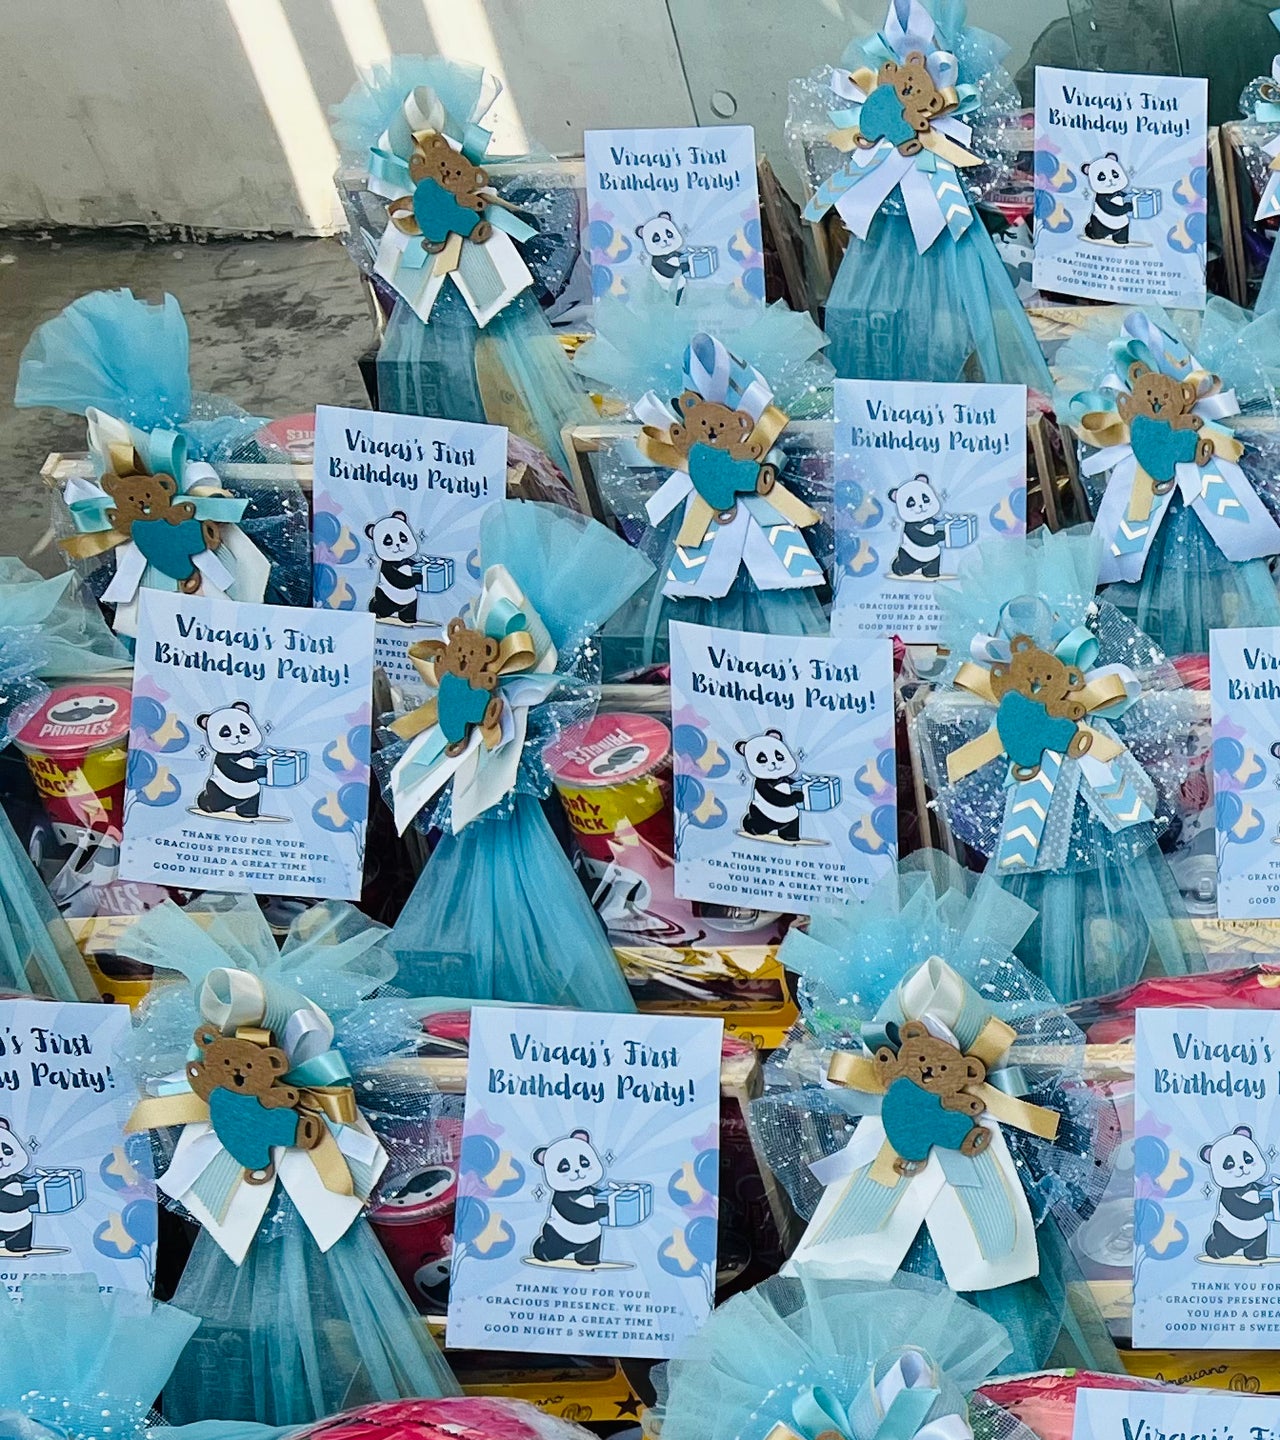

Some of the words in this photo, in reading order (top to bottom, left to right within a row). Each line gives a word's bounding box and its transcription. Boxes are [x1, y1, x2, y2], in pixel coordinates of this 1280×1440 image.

[176, 615, 275, 649] Viraaj's
[284, 628, 337, 656] First
[157, 644, 264, 680] Birthday
[276, 656, 350, 687] Party!
[39, 721, 112, 738] PRINGLES
[510, 1033, 614, 1067] Viraaj's
[623, 1040, 680, 1069] First
[491, 1069, 603, 1103] Birthday
[616, 1074, 695, 1106] Party!
